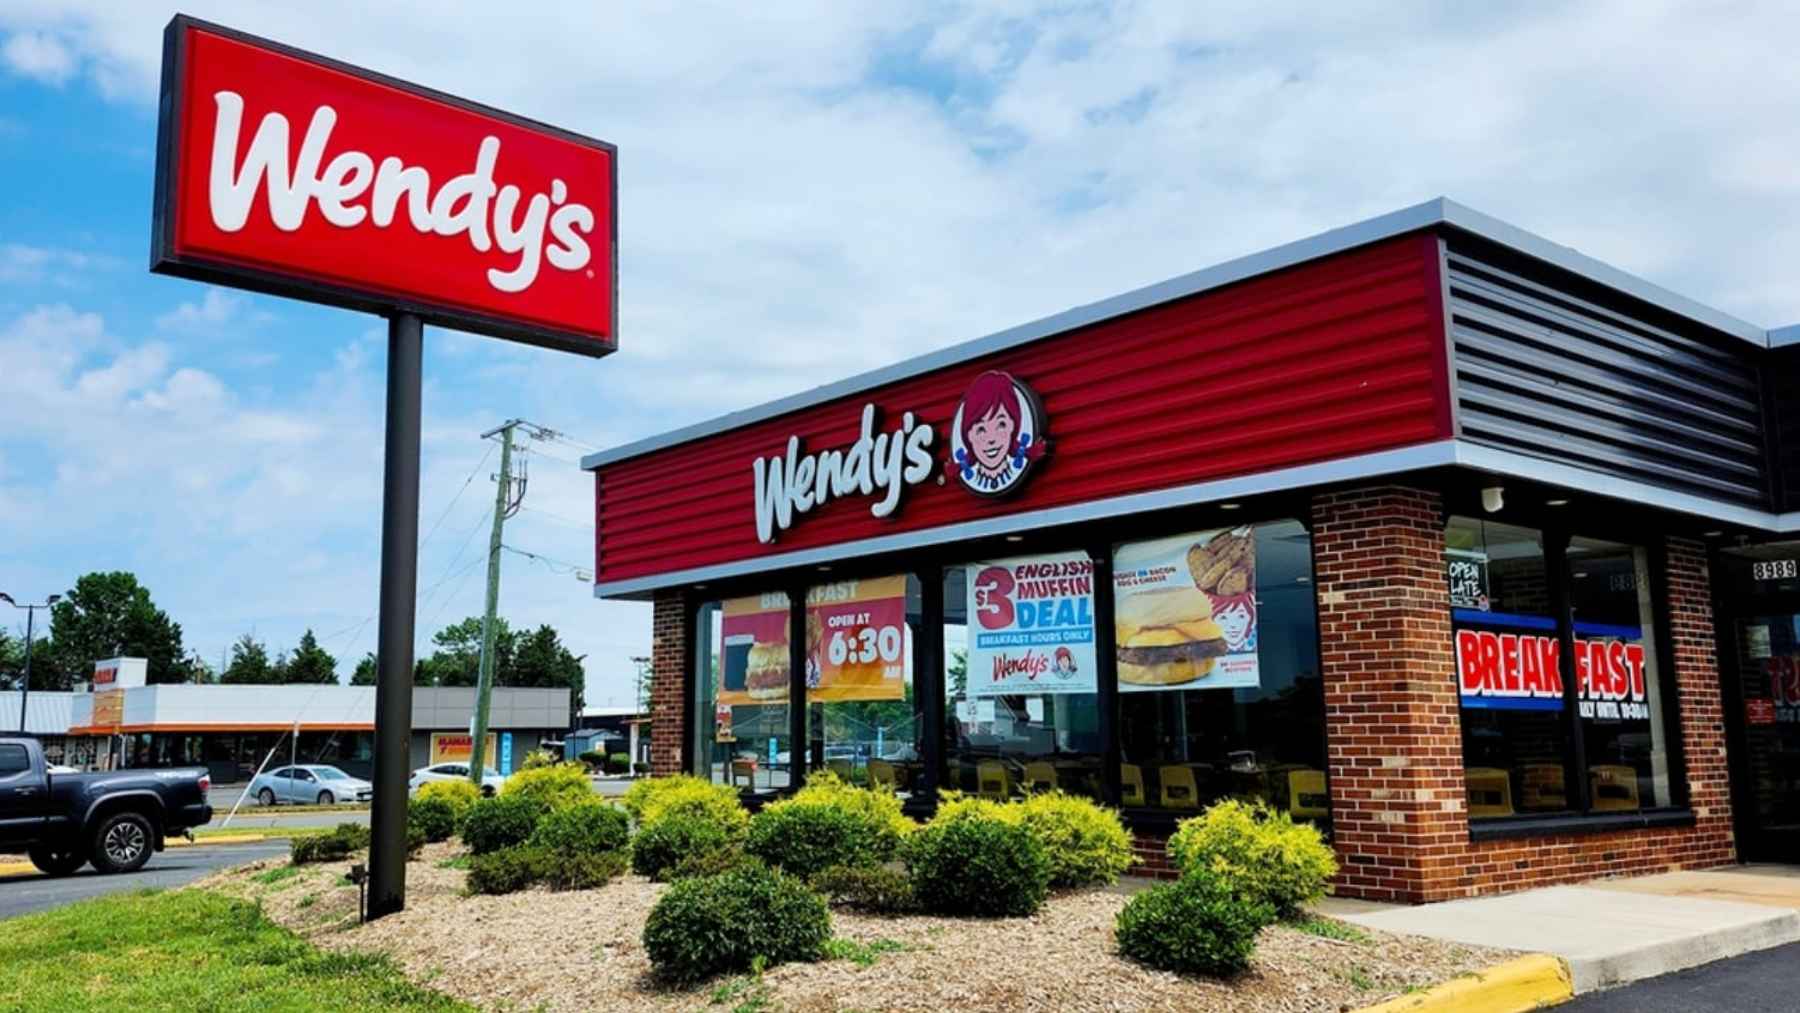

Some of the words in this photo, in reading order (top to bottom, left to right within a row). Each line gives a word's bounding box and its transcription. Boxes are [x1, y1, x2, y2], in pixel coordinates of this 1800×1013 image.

[209, 90, 595, 293] Wendy's
[753, 403, 934, 544] Wendy's
[1016, 560, 1093, 580] ENGLISH
[1449, 561, 1479, 580] OPEN
[1753, 560, 1796, 580] 8989
[1017, 576, 1091, 600] MUFFIN
[1450, 579, 1481, 598] LATE
[828, 615, 855, 628] OPEN
[857, 612, 870, 625] AT
[1016, 597, 1093, 629] DEAL
[828, 625, 901, 666] 6:30
[981, 634, 1029, 645] BREAKFAST
[1031, 632, 1062, 643] HOURS
[1063, 630, 1090, 641] ONLY
[992, 648, 1049, 682] Wendy's
